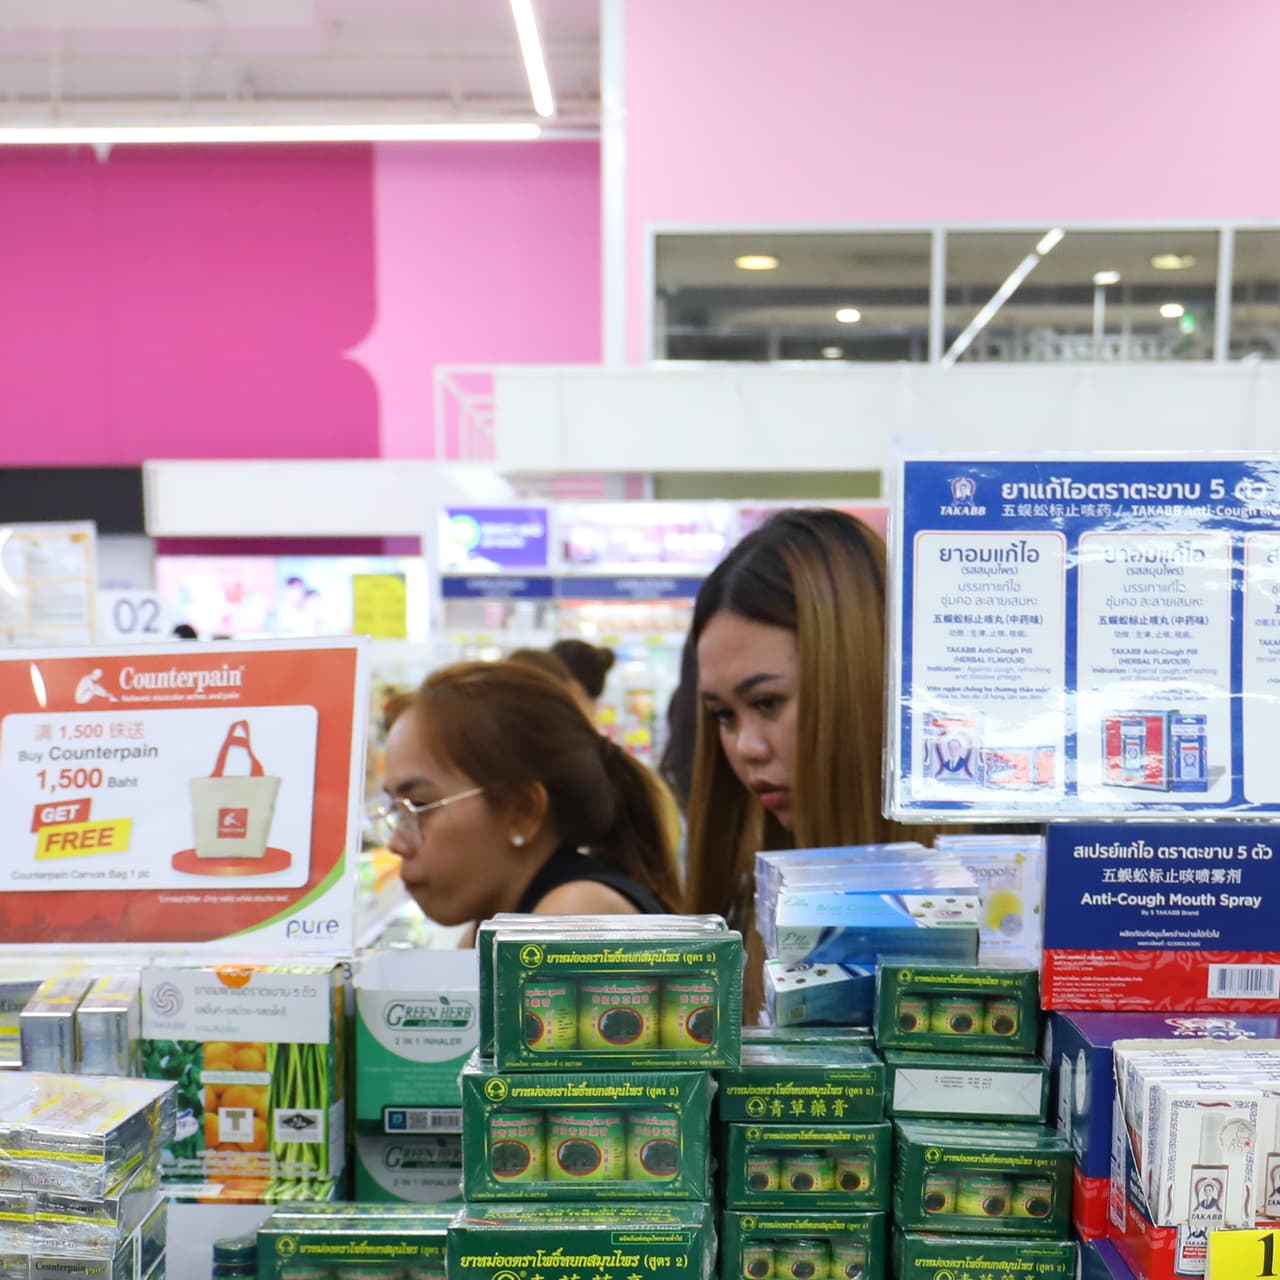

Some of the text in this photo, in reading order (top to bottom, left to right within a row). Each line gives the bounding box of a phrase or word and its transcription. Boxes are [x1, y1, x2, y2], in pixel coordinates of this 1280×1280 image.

[1001, 477, 1201, 500] ยาแก้ไอตราตะขาบ
[1209, 480, 1225, 500] 5
[940, 507, 987, 515] TAKABB
[939, 542, 1040, 564] ยาอมแก้ไอ
[113, 597, 161, 634] 02
[119, 664, 241, 691] Counterpain
[19, 743, 158, 762] Buy Counterpain
[36, 768, 138, 792] 1,500 Baht
[41, 805, 80, 823] GET
[44, 827, 114, 852] FREE
[1073, 841, 1272, 860] สเปรย์แก้ไอ ตราตะขาบ 5 ตัว
[1102, 868, 1241, 884] 五蜈蚣标止咳喷雾剂
[1081, 892, 1262, 908] Anti-Cough Mouth Spray
[286, 917, 340, 942] pure
[387, 1003, 472, 1026] GREEN HERB
[460, 1248, 688, 1271] ยาหม่องตราโพธิ์หยกสมุนไพร (สูตร 2)
